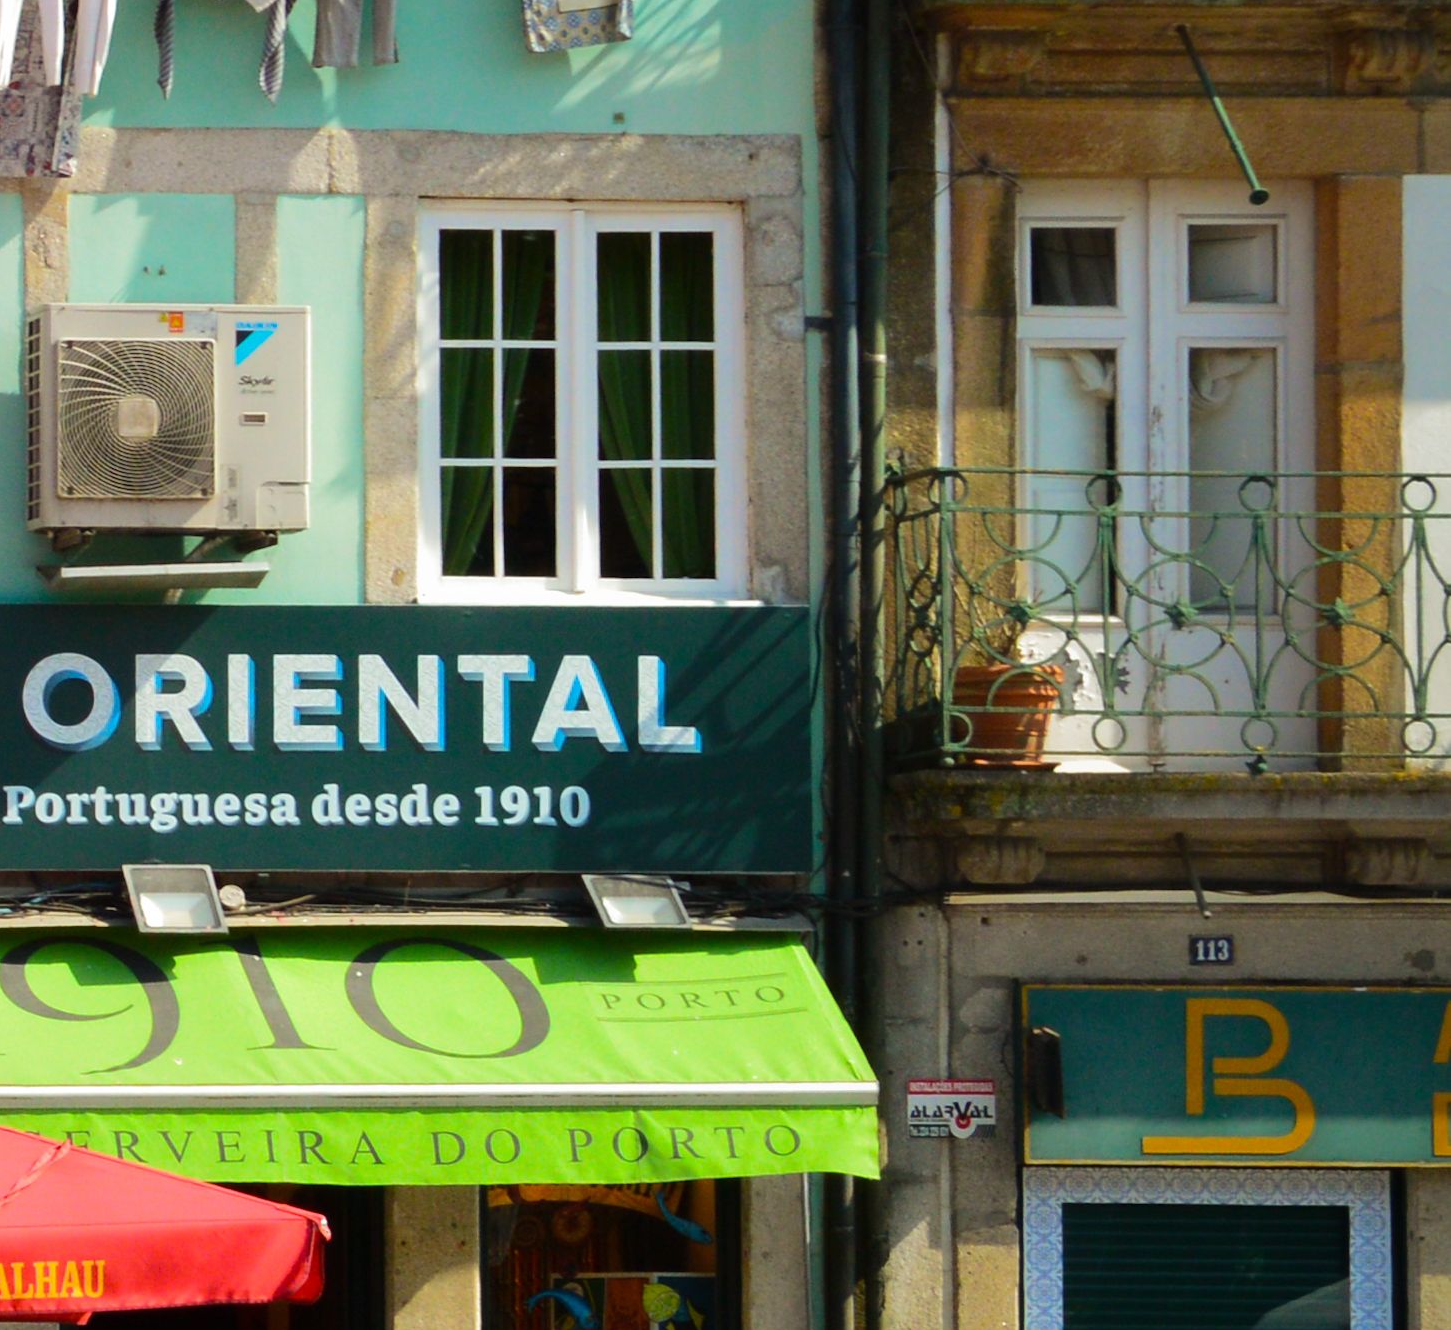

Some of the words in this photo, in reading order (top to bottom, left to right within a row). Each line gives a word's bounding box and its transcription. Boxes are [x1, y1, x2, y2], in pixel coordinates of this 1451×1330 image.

[22, 652, 702, 753] ORIENTAL
[2, 785, 300, 832] Portuguesa
[311, 783, 460, 826] desde
[474, 785, 591, 827] 1910
[1197, 939, 1230, 961] 113
[599, 985, 788, 1012] PORTO
[432, 1127, 520, 1164] DO
[569, 1124, 804, 1161] PORTO
